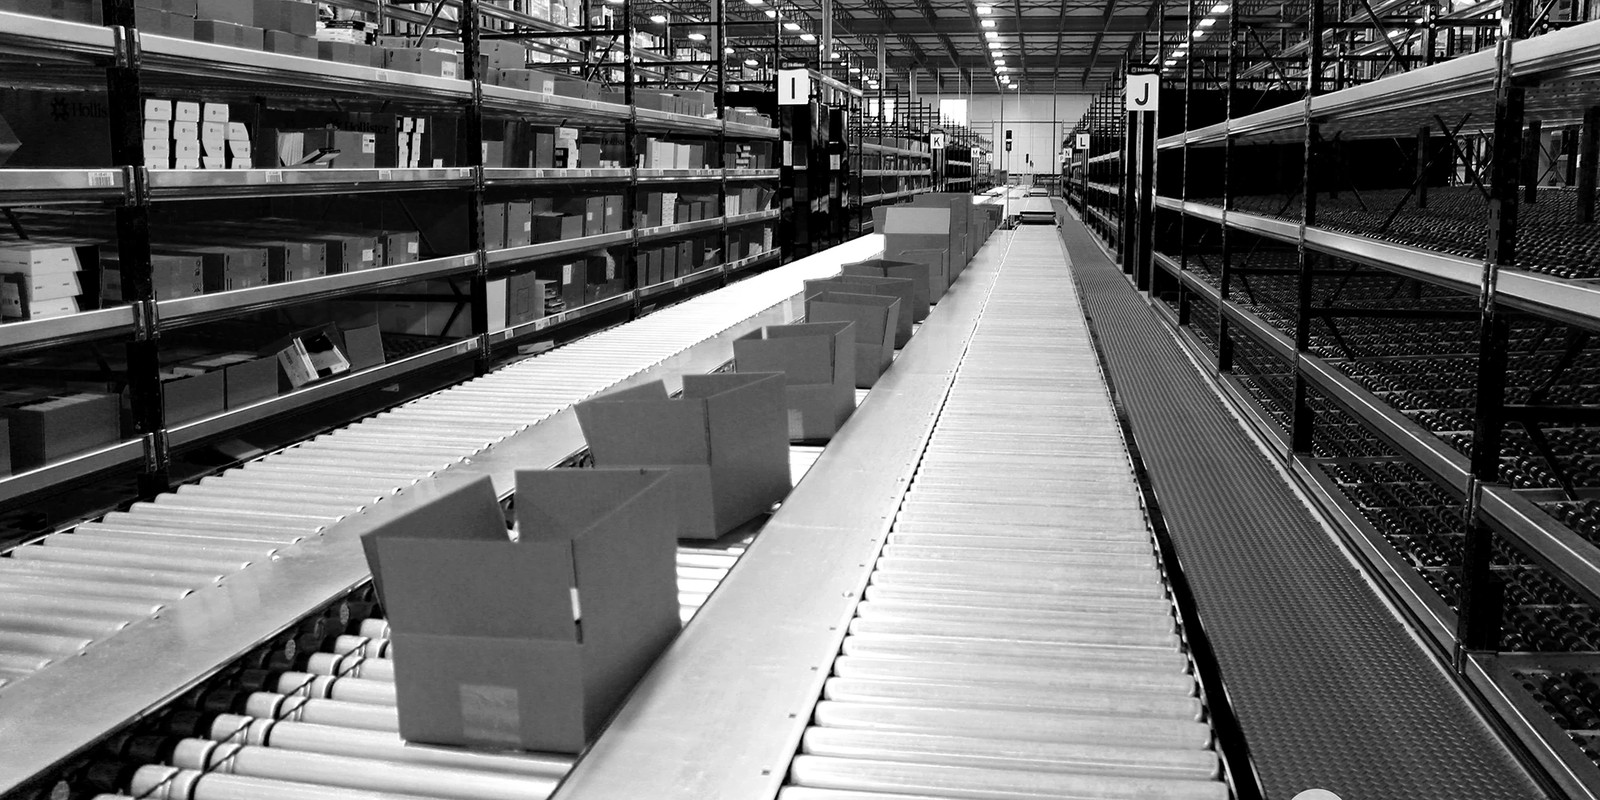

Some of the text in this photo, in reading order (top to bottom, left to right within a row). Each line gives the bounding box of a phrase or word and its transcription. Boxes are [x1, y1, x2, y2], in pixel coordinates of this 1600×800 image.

[791, 77, 796, 99] I
[1135, 82, 1149, 106] J
[933, 136, 941, 147] K
[1080, 137, 1086, 147] L
